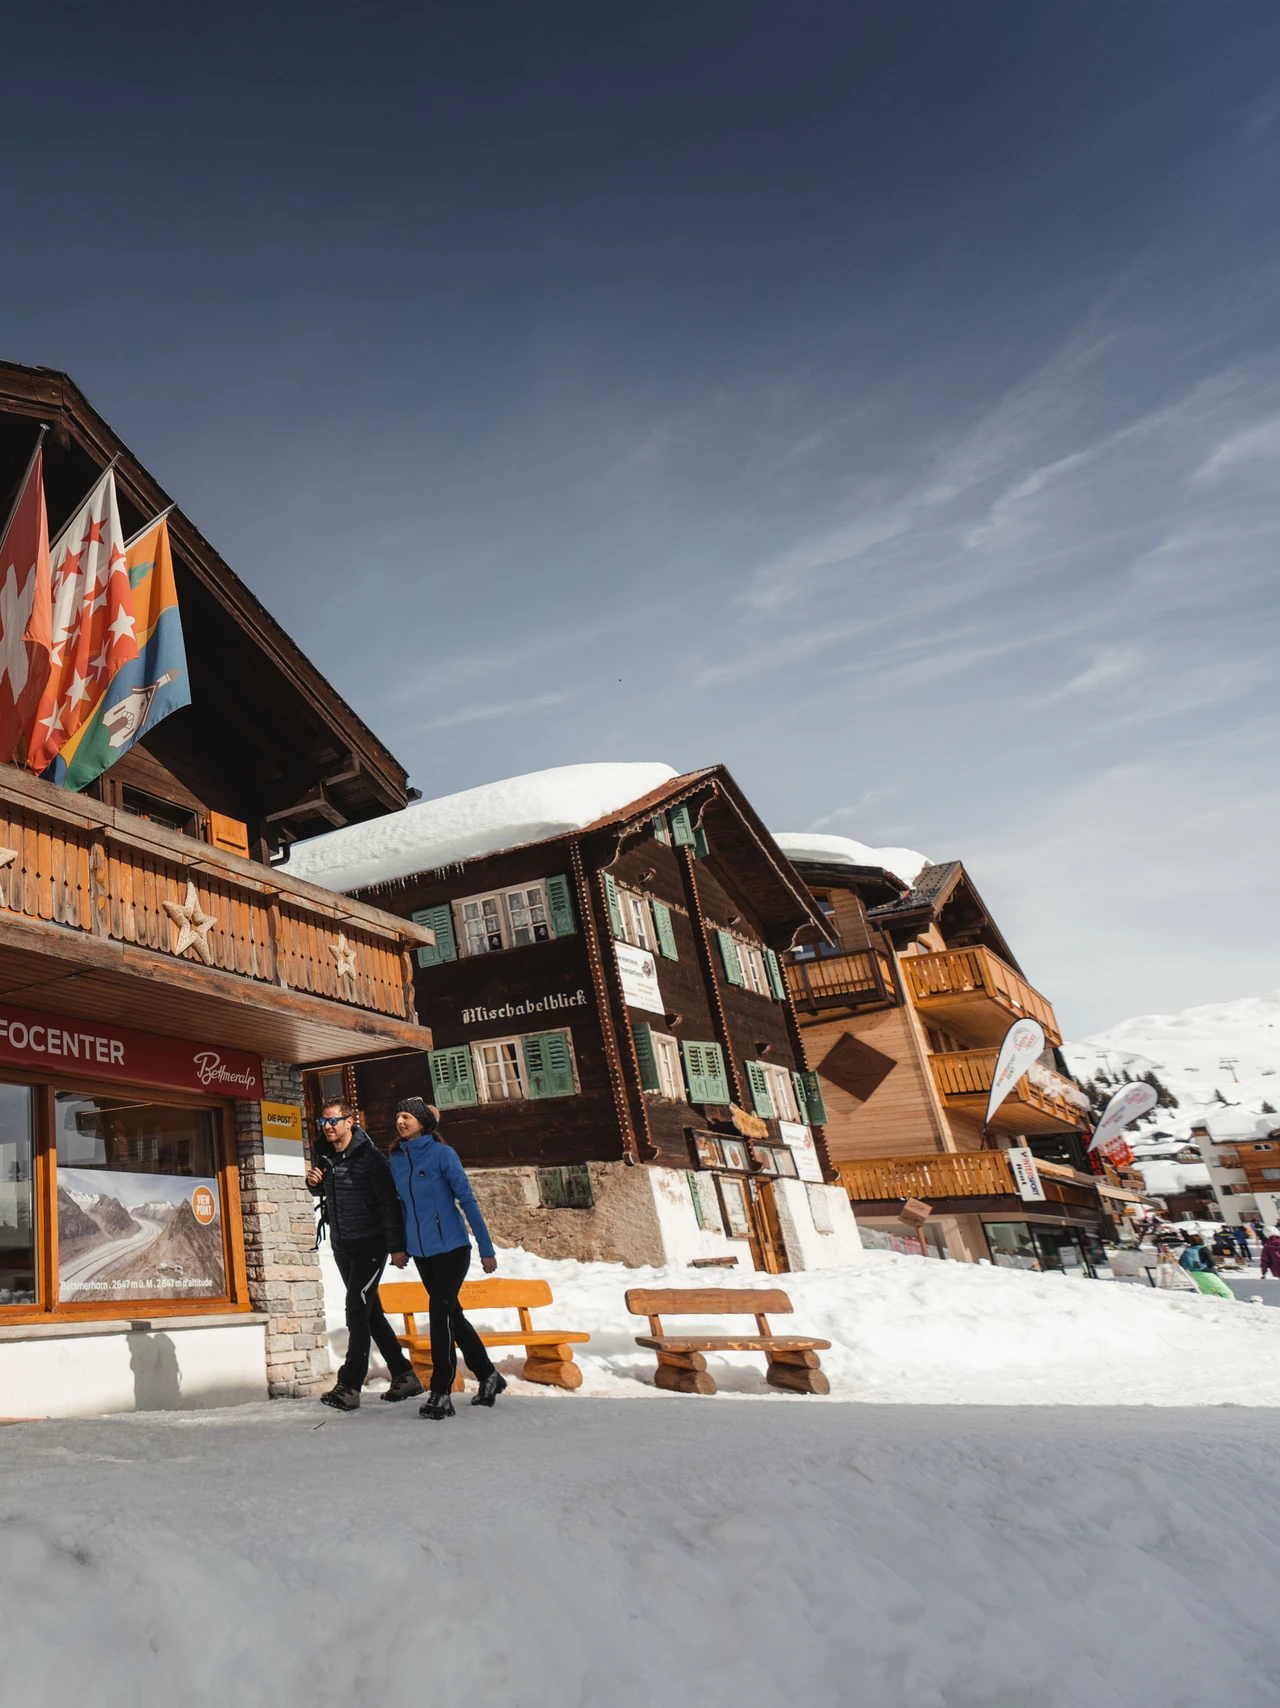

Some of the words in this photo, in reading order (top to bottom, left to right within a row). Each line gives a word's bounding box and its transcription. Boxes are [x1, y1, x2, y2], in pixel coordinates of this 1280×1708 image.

[461, 989, 587, 1024] Mischabelblick
[193, 1052, 256, 1090] Bettmeralp
[267, 1113, 277, 1123] DIE
[277, 1115, 291, 1124] POST
[1015, 1163, 1028, 1186] Rent
[1022, 1158, 1041, 1197] INTERSPORT
[196, 1195, 210, 1205] VIEW
[196, 1204, 212, 1216] POINT
[60, 1280, 108, 1291] Bettmerhorn
